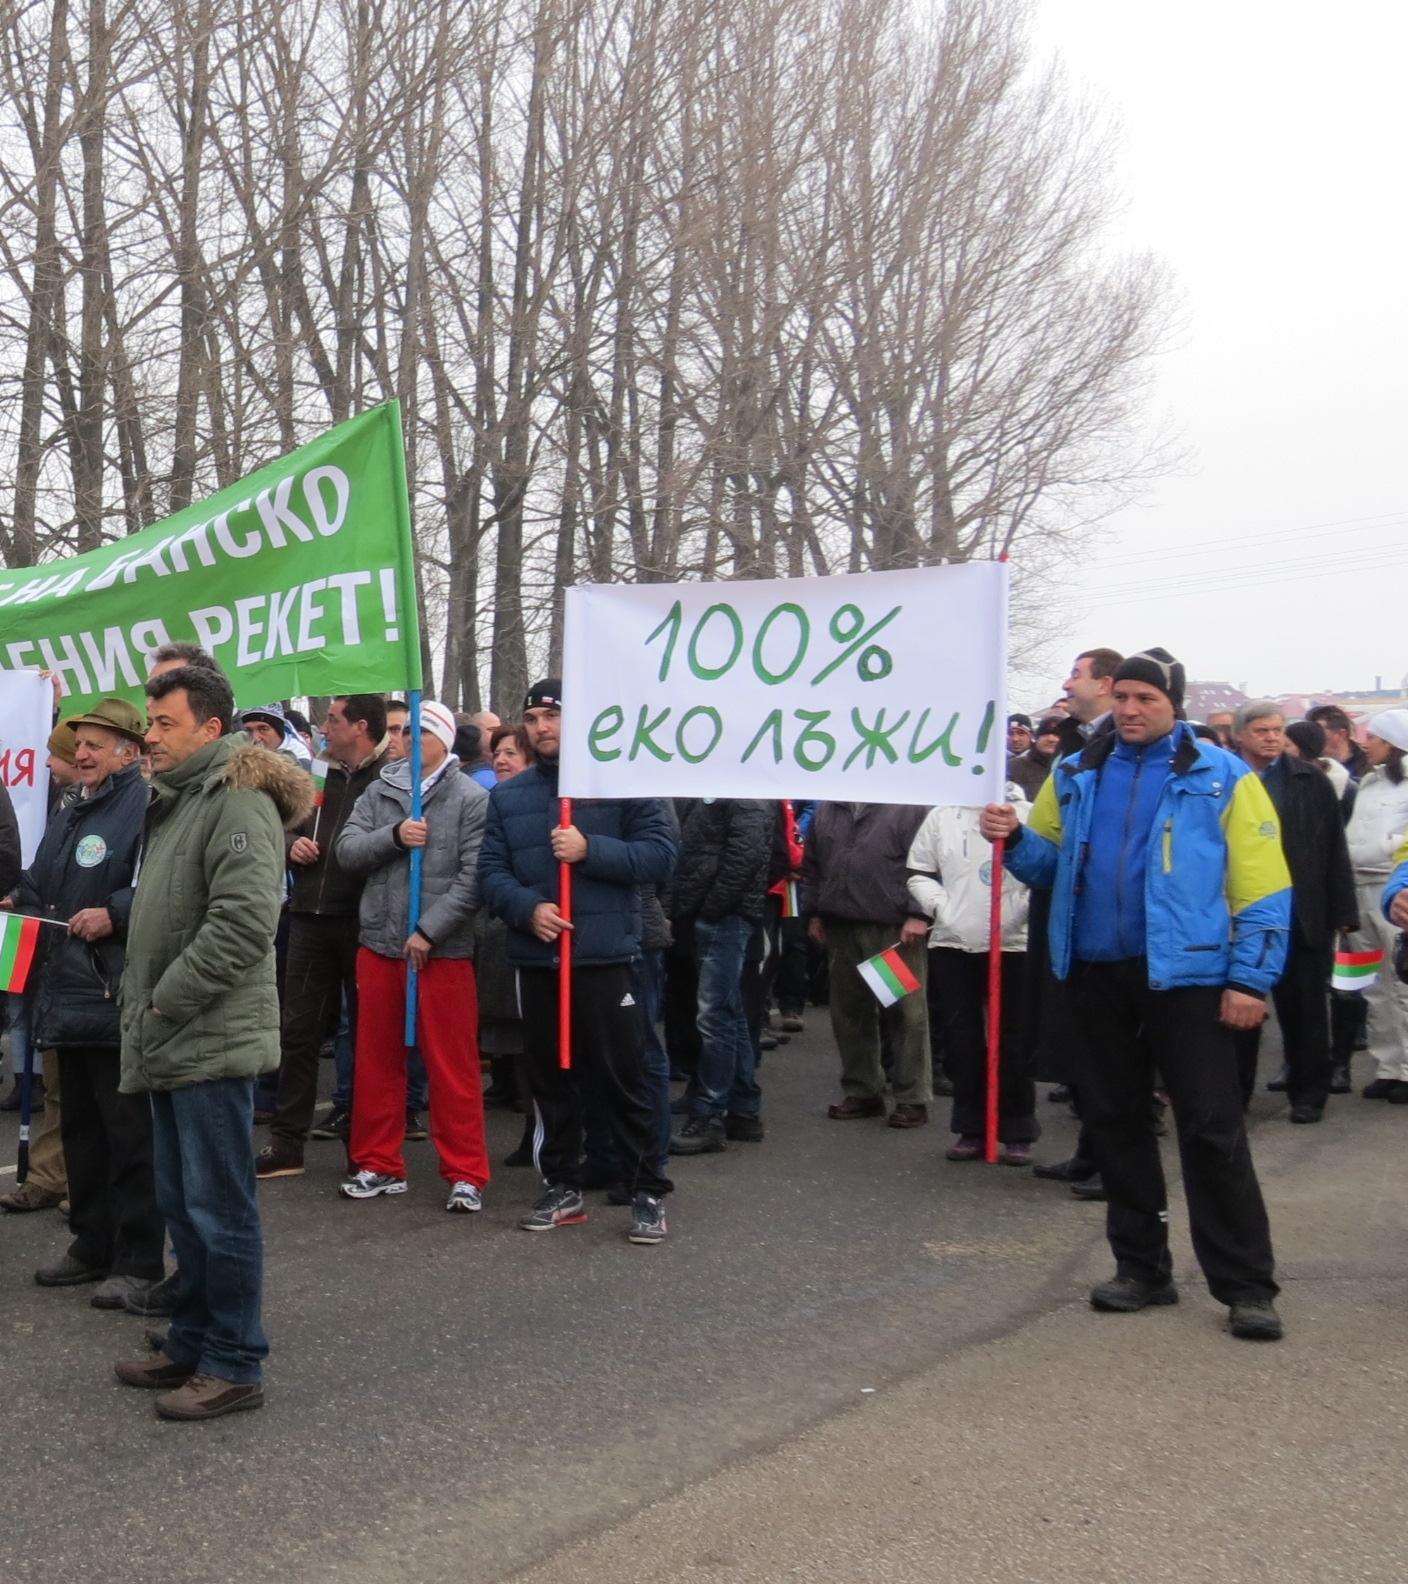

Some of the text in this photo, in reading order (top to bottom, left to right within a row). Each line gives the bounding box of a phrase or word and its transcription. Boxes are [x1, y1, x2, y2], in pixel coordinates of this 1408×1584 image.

[85, 465, 350, 592] БАНСКО
[188, 567, 399, 668] РЕКЕТ!
[644, 599, 903, 687] 100%
